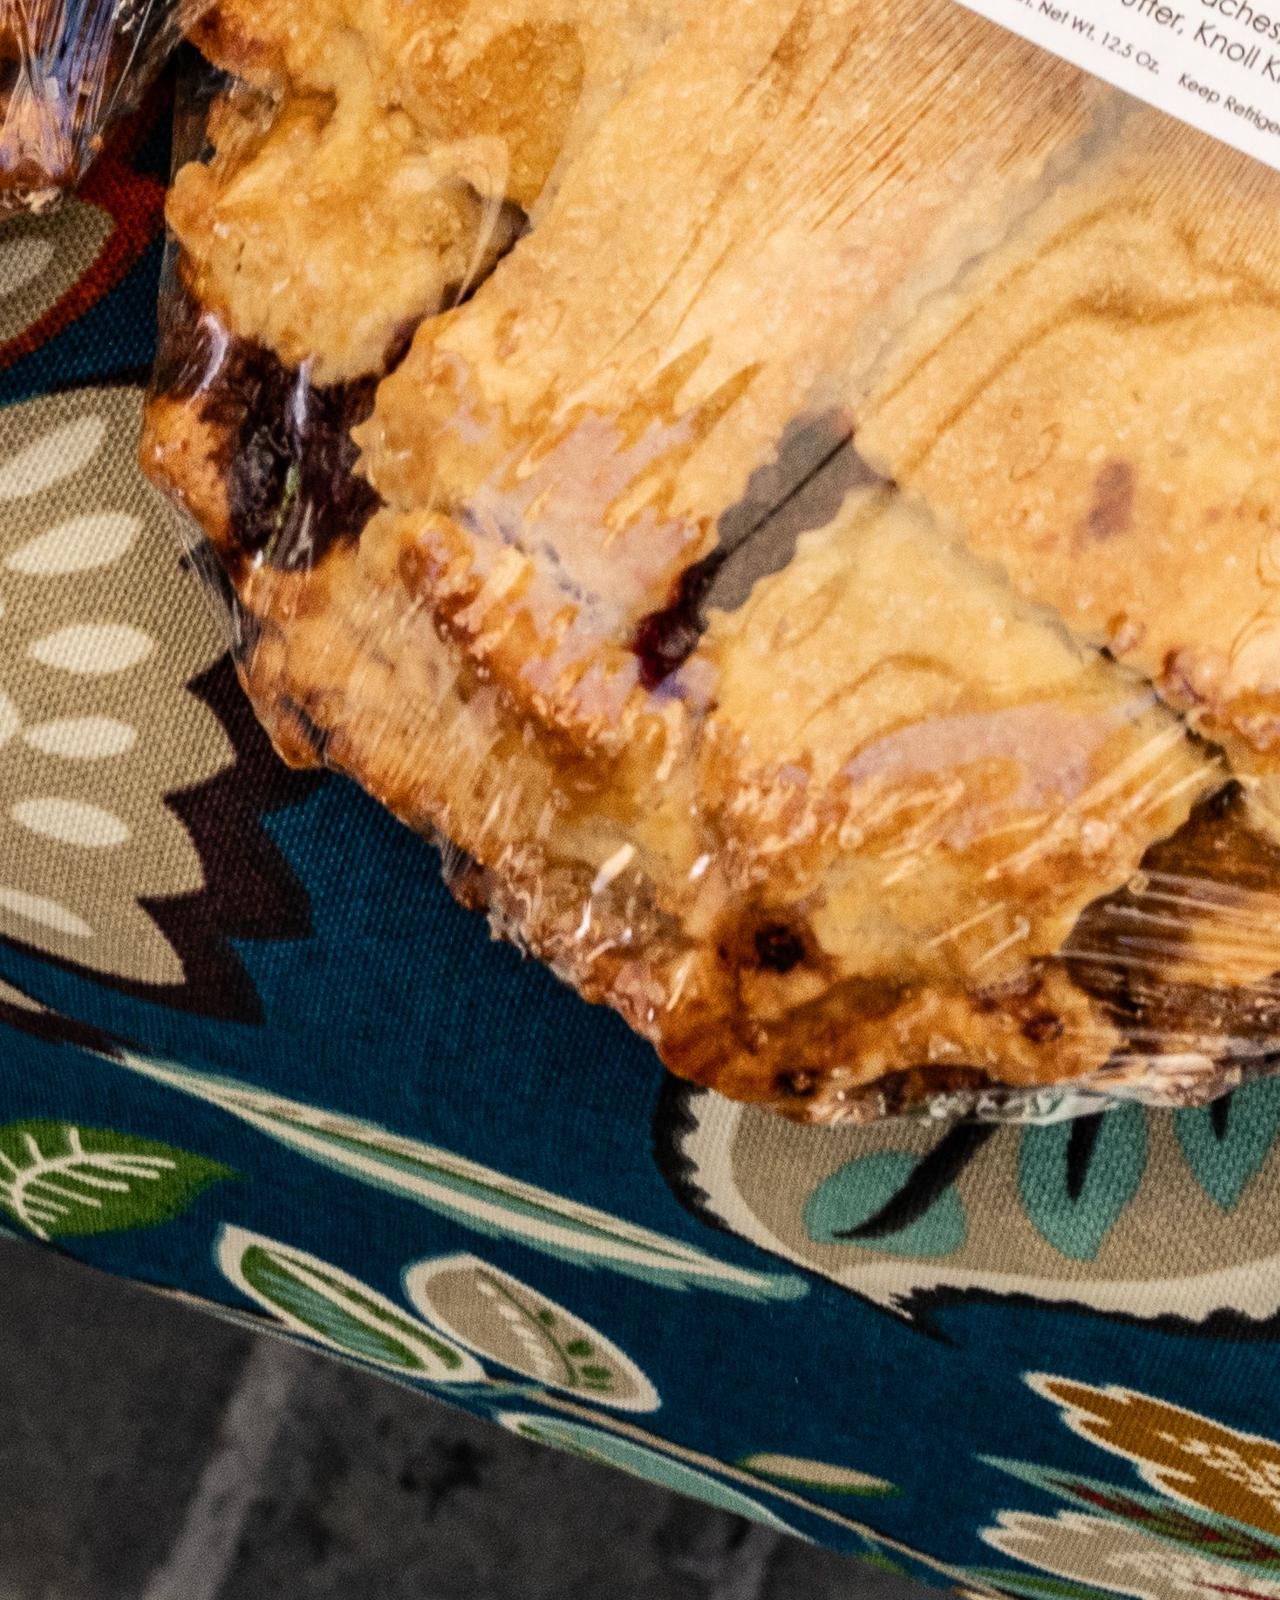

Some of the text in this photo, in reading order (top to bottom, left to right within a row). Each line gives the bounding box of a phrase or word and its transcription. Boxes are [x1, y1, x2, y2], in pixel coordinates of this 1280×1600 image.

[1038, 0, 1070, 25] Net
[1072, 16, 1096, 40] Wt.
[1101, 31, 1134, 59] 12.5
[1193, 19, 1262, 70] Knoll
[1177, 72, 1221, 104] Keep
